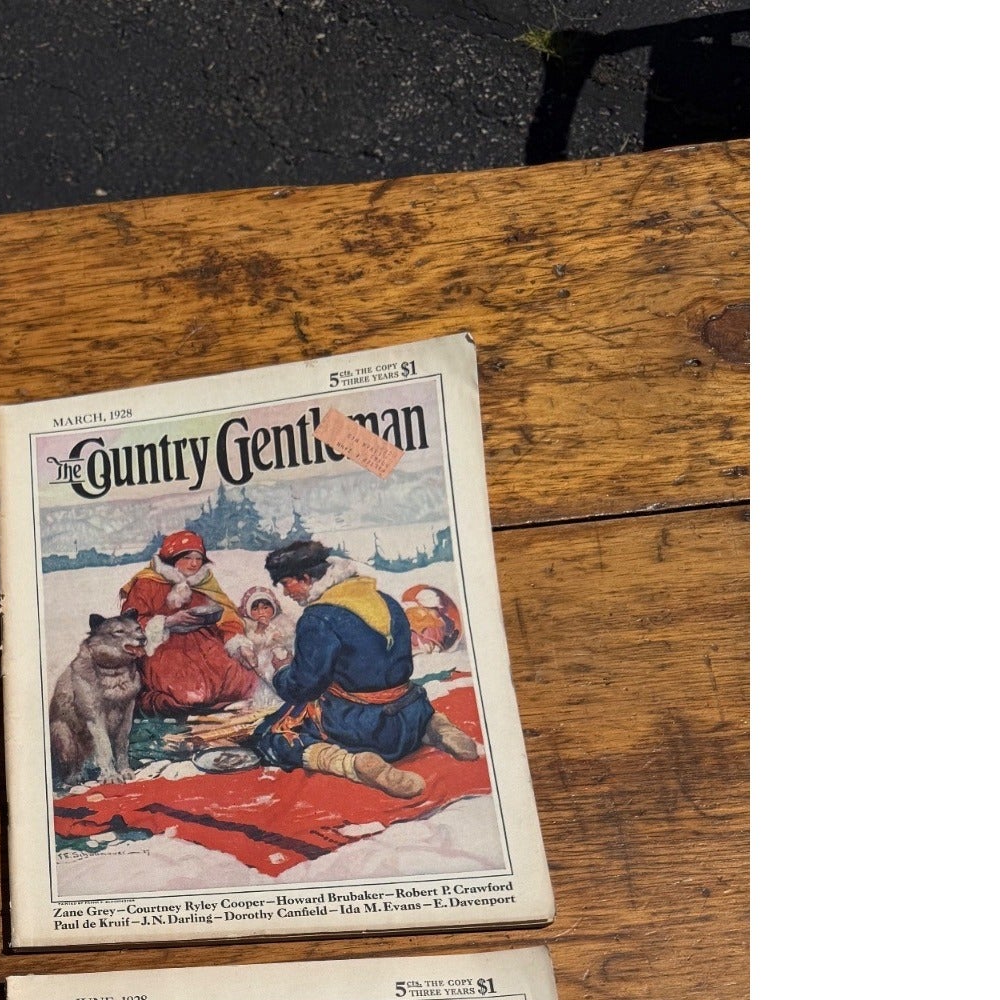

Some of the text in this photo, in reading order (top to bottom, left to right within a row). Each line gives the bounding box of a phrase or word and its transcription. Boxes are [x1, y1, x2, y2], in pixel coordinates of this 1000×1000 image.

[330, 373, 340, 388] 5
[355, 366, 373, 375] THE
[375, 363, 398, 372] COPY
[341, 360, 418, 387] THREE YEARS $1
[53, 409, 133, 428] MARCH, 1928
[47, 456, 83, 485] The
[69, 434, 211, 499] Country
[52, 906, 84, 918] Zane
[184, 898, 217, 913] Ryley
[440, 884, 451, 896] P.
[453, 881, 513, 895] Crawford
[54, 918, 79, 930] Paul
[82, 917, 96, 929] de
[364, 901, 381, 913] M.
[449, 895, 515, 909] Davenport
[395, 981, 407, 998] 5
[448, 979, 473, 987] COPY
[409, 988, 442, 997] THREE
[477, 978, 497, 996] $1
